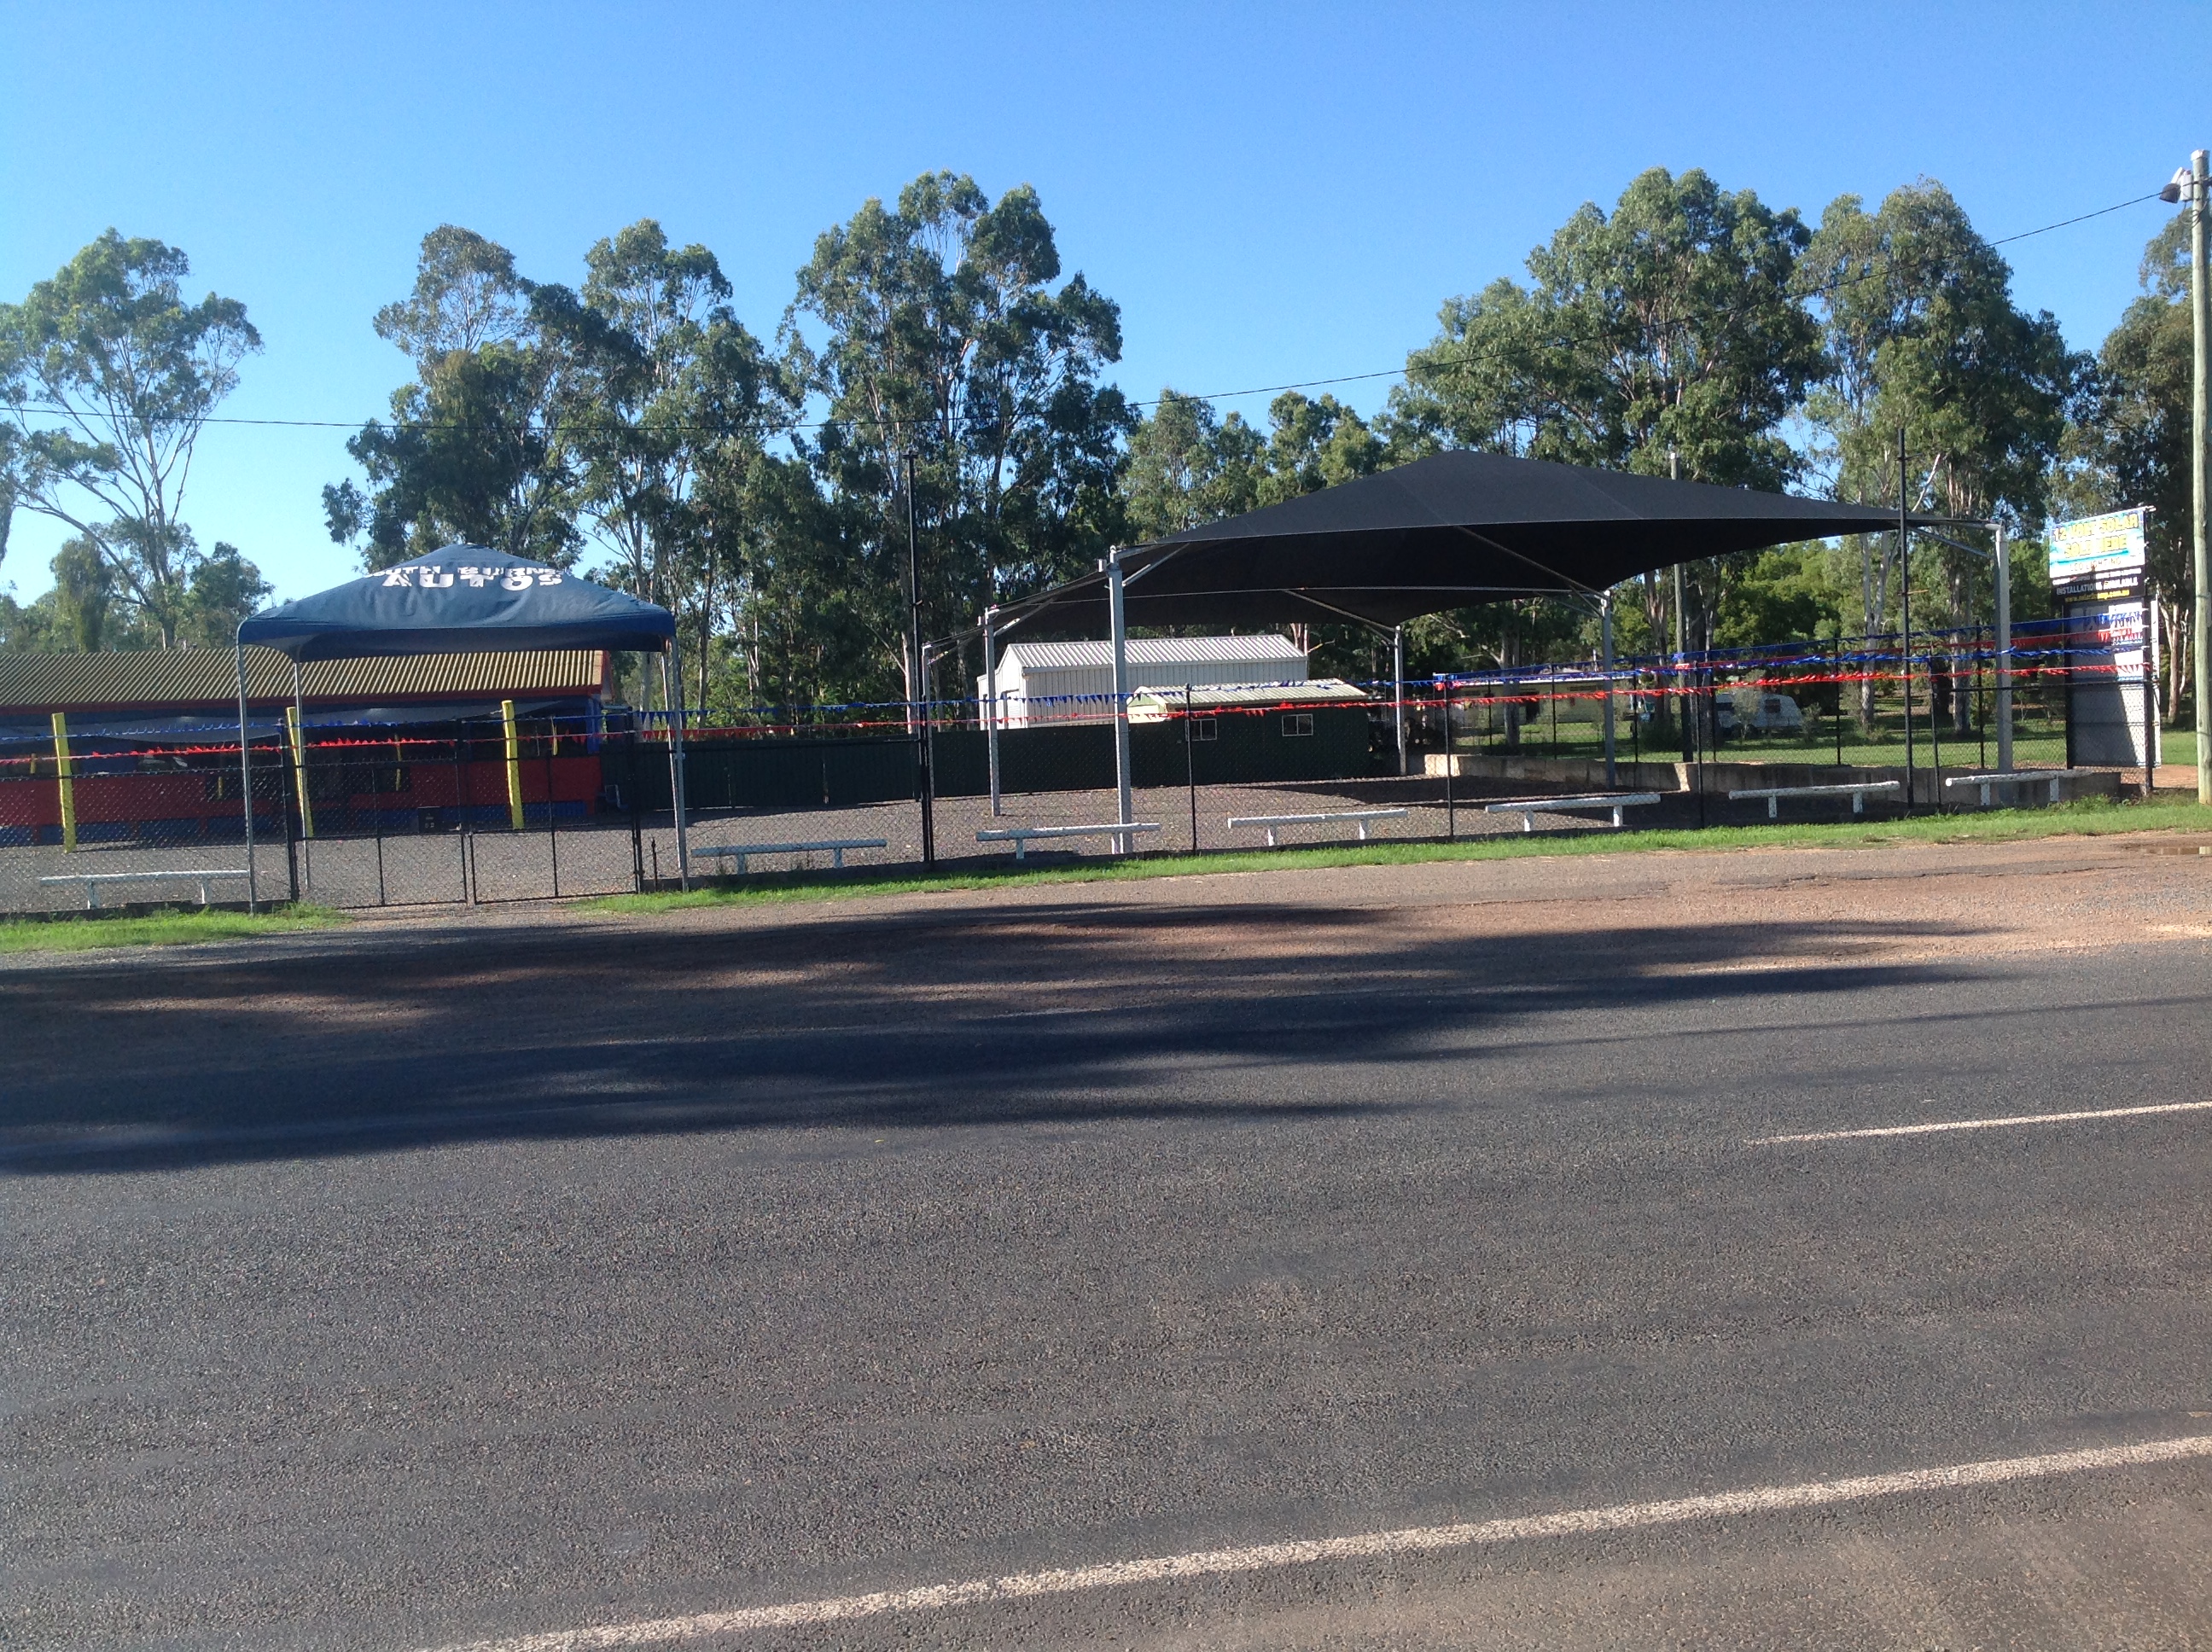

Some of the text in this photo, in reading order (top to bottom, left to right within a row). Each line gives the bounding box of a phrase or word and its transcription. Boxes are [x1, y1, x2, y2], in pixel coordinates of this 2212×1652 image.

[2053, 513, 2139, 542] 12 VOLT SOLAR
[2064, 533, 2128, 558] SOLD HERE
[381, 573, 563, 591] AUTOS
[2103, 576, 2139, 590] AVAILABLE
